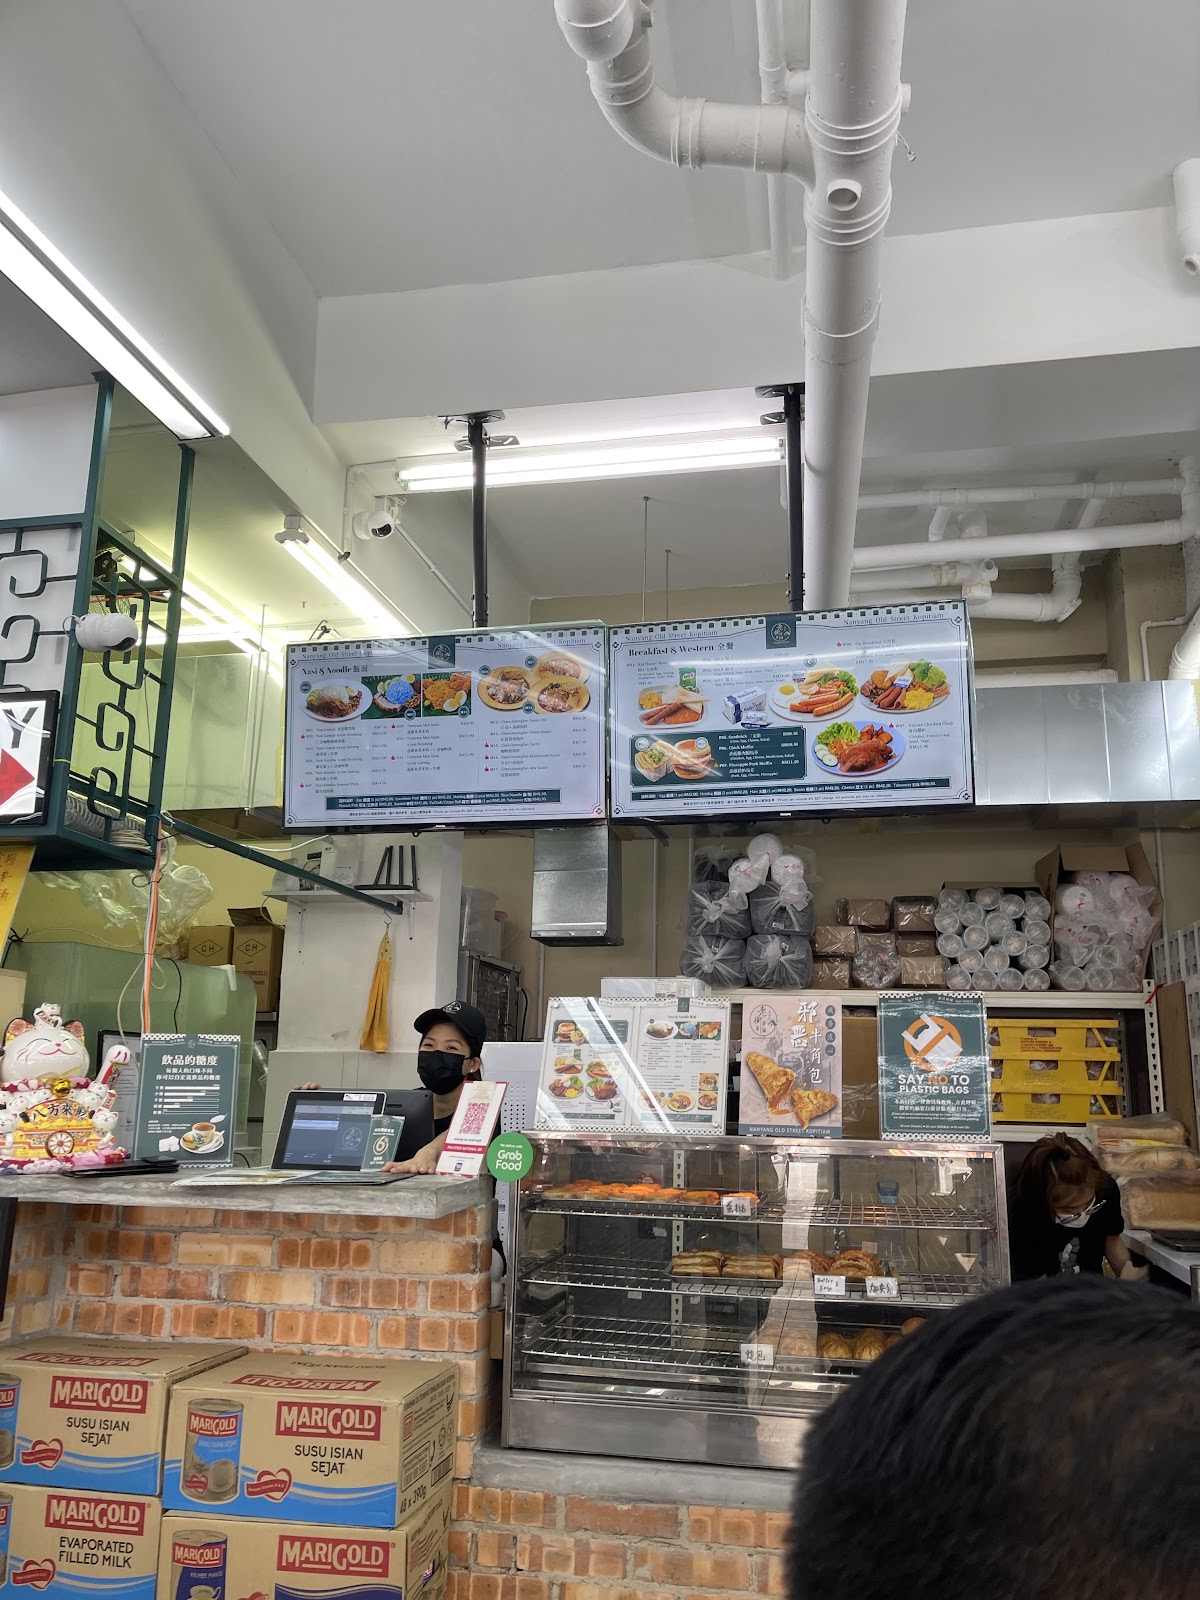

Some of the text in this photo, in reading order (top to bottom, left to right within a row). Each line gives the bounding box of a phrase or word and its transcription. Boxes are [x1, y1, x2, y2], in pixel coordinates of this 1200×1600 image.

[843, 617, 872, 627] Nanyang
[875, 616, 887, 624] Old
[912, 612, 944, 621] Kopitiam
[558, 637, 586, 646] Kopitiam
[689, 630, 718, 638] Kopitiam
[628, 647, 668, 657] Breakfast
[670, 647, 677, 656] &
[679, 644, 714, 653] Western
[302, 668, 318, 676] Nasi
[319, 667, 325, 677] &
[326, 665, 352, 675] Noodle
[161, 1054, 219, 1066] 飲品的糖度
[809, 1028, 823, 1084] 牛角包
[897, 1074, 970, 1085] SAY NO TO
[899, 1085, 970, 1095] PLASTIC BAGS
[497, 1149, 523, 1161] Grab
[495, 1160, 522, 1171] Food
[240, 1376, 371, 1391] MARIGOLD
[53, 1379, 144, 1409] MARIGOLD
[66, 1416, 130, 1432] SUSU ISIAN
[190, 1415, 236, 1435] MARIGOLD
[279, 1405, 377, 1434] MARIGOLD
[80, 1432, 113, 1447] SEJAT
[294, 1444, 364, 1460] SUSU ISIAN
[311, 1460, 345, 1476] SEJAT
[400, 1484, 427, 1514] 48 x 390g
[49, 1498, 141, 1529] MARIGOLD
[59, 1536, 134, 1554] EVAPORATED
[58, 1550, 132, 1569] FILLED MILK
[174, 1547, 221, 1564] MARIGOLD
[281, 1540, 384, 1570] MARIGOLD
